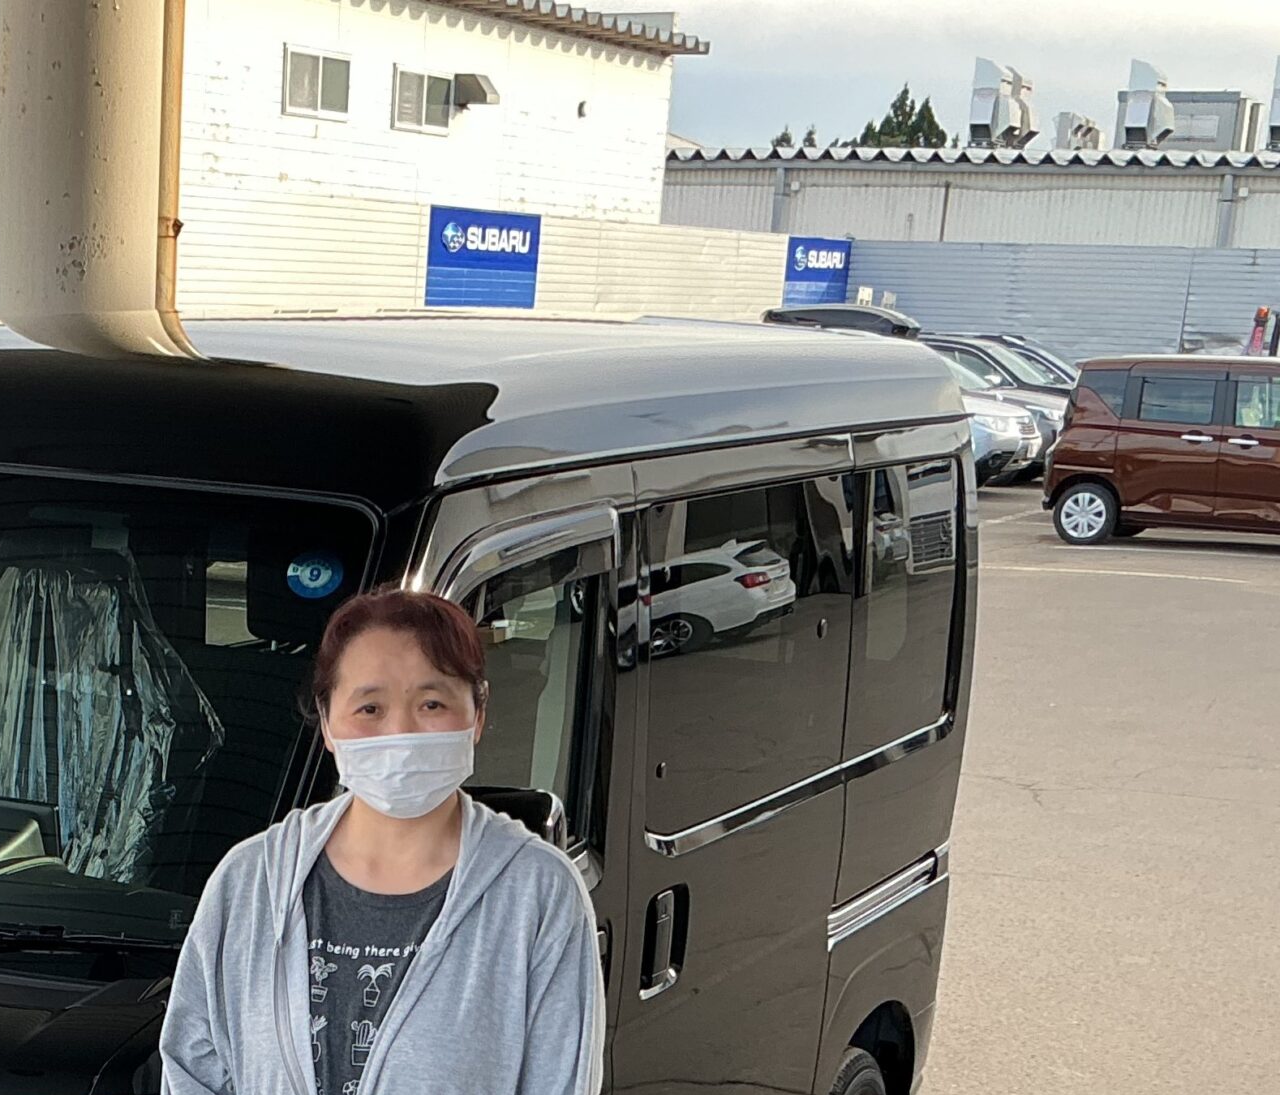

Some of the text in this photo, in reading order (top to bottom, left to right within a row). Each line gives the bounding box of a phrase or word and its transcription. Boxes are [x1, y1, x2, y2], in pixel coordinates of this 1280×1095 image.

[465, 226, 531, 254] SUBARU
[807, 250, 846, 269] SUBARU
[308, 566, 322, 582] 9
[326, 941, 361, 960] being
[365, 944, 401, 957] there
